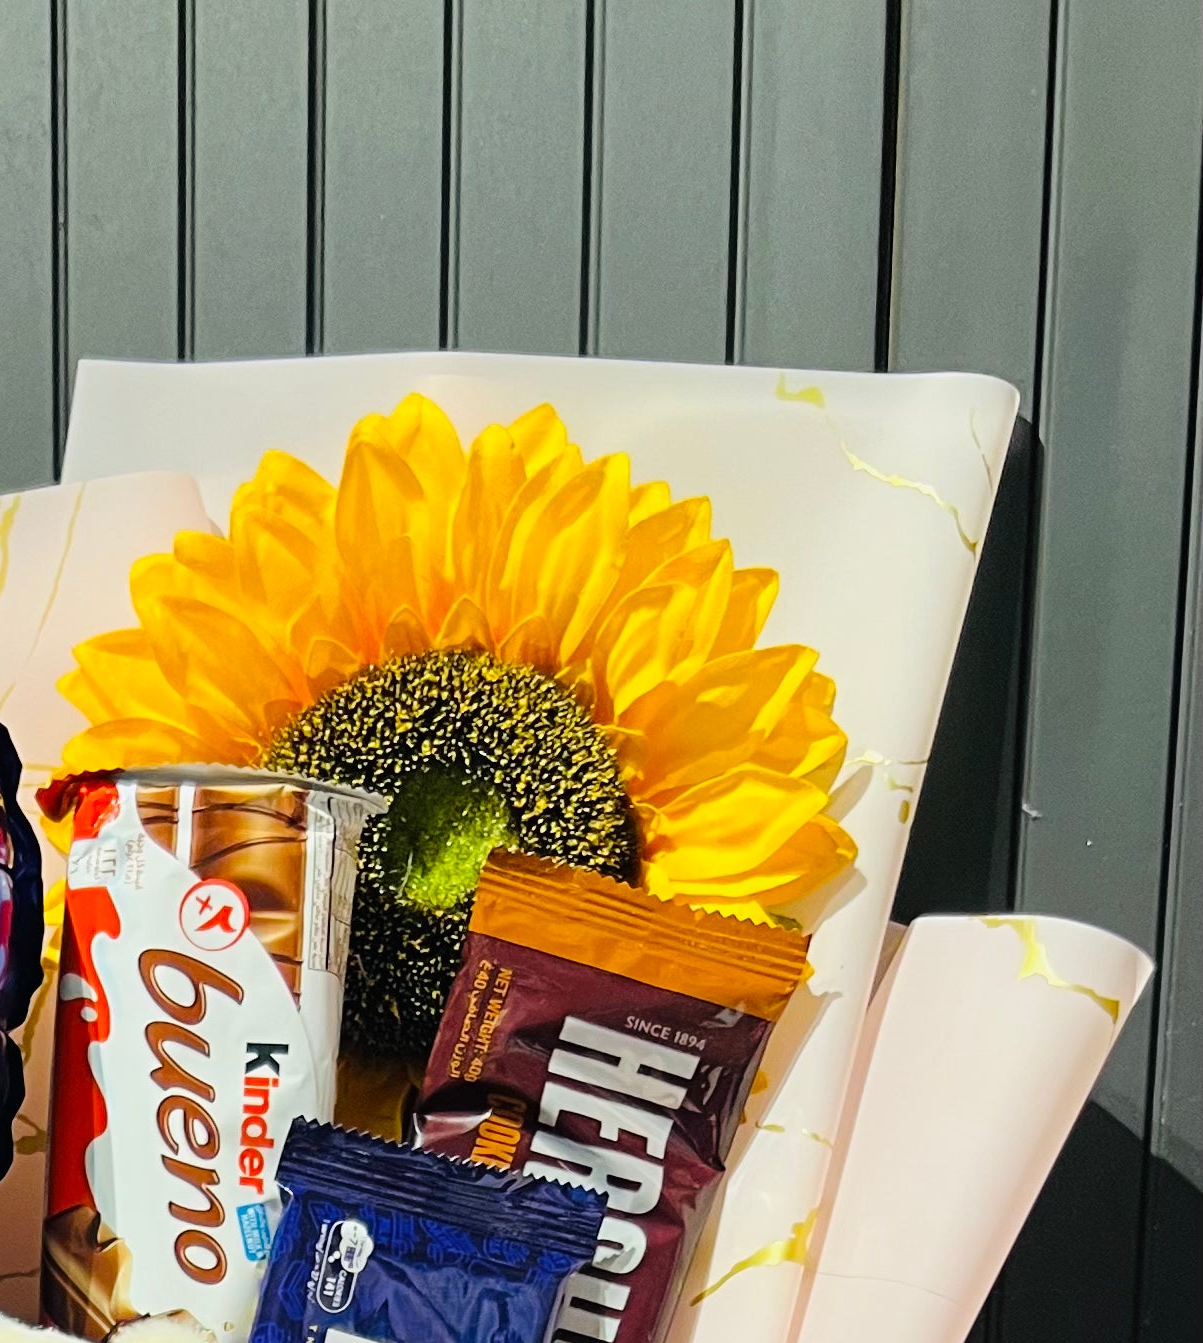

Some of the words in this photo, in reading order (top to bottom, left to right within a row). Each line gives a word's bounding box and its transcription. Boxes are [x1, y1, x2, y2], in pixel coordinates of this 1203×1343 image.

[494, 967, 513, 997] NET
[476, 998, 504, 1054] WEIGHT:
[624, 1015, 672, 1040] SINCE
[673, 1030, 707, 1051] 1894
[464, 1057, 484, 1083] 40g
[138, 948, 244, 1285] bueno
[238, 1042, 290, 1195] kinder
